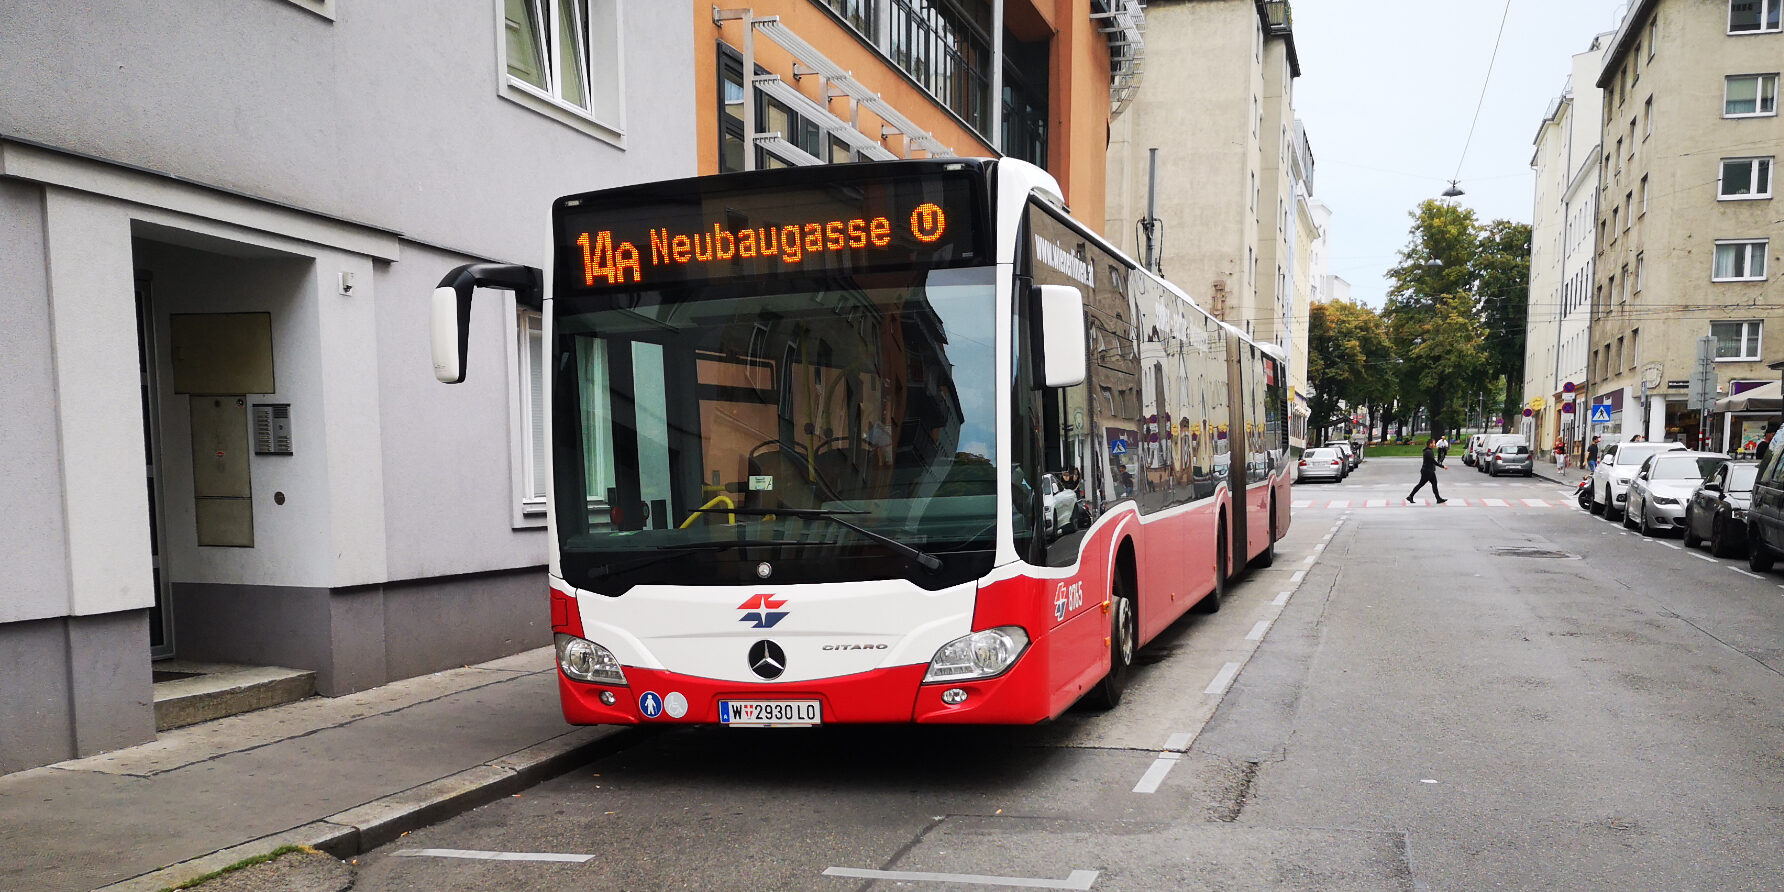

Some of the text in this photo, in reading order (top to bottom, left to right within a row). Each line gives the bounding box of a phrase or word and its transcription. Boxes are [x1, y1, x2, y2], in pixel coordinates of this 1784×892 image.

[576, 230, 642, 286] 14A
[649, 216, 892, 265] Neubaugasse
[731, 704, 743, 720] W
[754, 704, 793, 720] 2930
